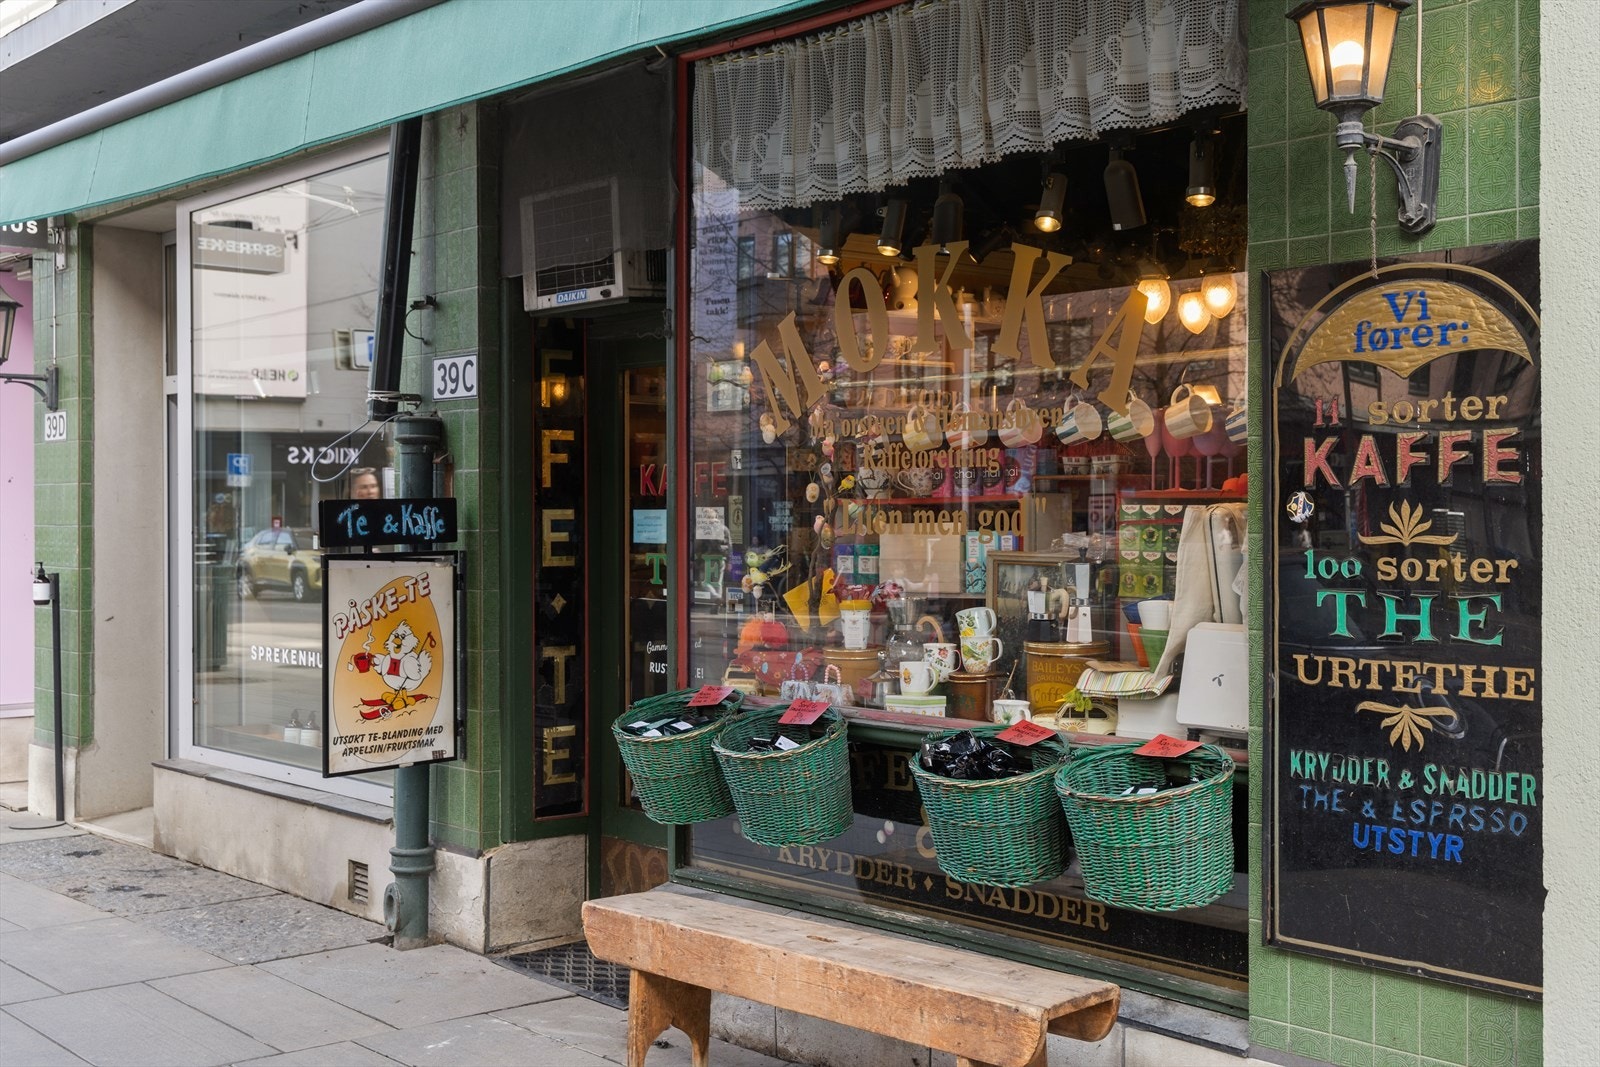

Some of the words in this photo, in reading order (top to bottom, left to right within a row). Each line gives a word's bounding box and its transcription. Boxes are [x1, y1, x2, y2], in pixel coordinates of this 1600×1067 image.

[557, 290, 587, 303] DAIKIN
[1383, 290, 1431, 323] Vi
[749, 239, 1149, 438] MOKKA
[1353, 320, 1469, 354] fører:
[437, 360, 475, 396] 39C
[1368, 391, 1508, 426] sorter
[46, 415, 66, 438] 39D
[954, 468, 976, 479] chai
[1303, 427, 1525, 490] KAFFE
[337, 503, 369, 539] Te
[383, 513, 399, 534] &
[401, 503, 446, 540] Kaffe
[913, 508, 968, 536] men
[1377, 550, 1519, 583] sorter
[333, 571, 432, 639] PÅSKE-TE
[1316, 589, 1504, 646] THE
[250, 644, 323, 669] SPREKENHU
[649, 661, 668, 674] RUS
[1032, 661, 1081, 674] BAILEYS
[1293, 654, 1535, 702] URTETHE
[1033, 687, 1064, 705] Coff
[333, 733, 365, 746] UTSØKT
[368, 727, 423, 742] TE-BLANDING
[425, 725, 444, 735] MED
[342, 738, 436, 757] APPELSIN/FRUKTSMAK
[1290, 749, 1390, 790] KRYDDER
[1398, 768, 1414, 790] &
[1424, 763, 1537, 807] SNADDER
[1300, 784, 1347, 812] THE
[1363, 799, 1377, 819] &
[1353, 822, 1465, 864] UTSTYR
[777, 844, 916, 891] KRYDDER
[945, 877, 1110, 931] SNADDER
